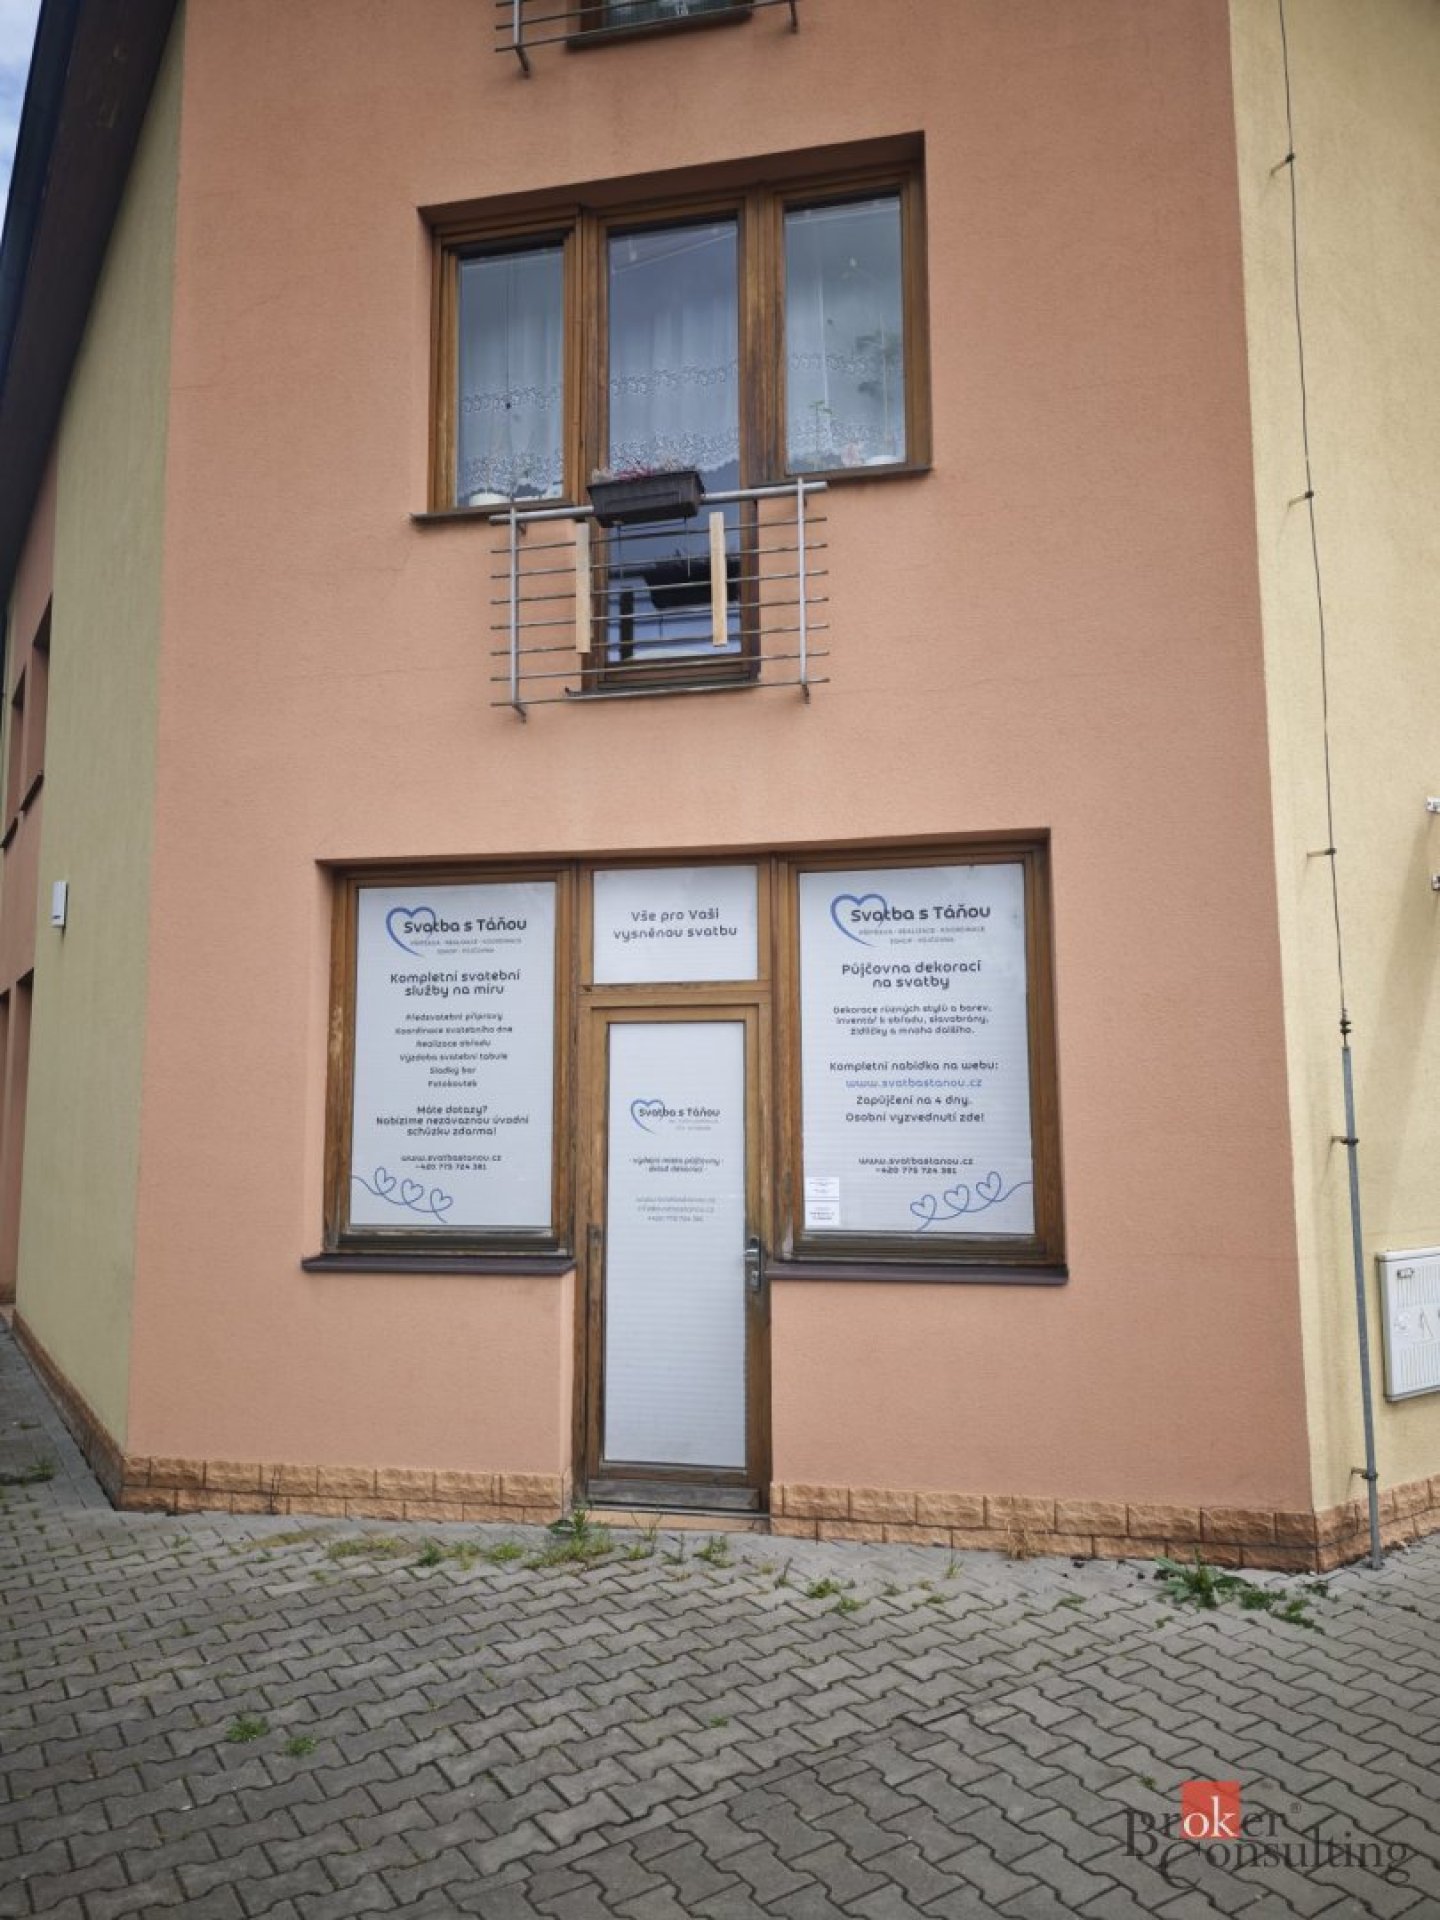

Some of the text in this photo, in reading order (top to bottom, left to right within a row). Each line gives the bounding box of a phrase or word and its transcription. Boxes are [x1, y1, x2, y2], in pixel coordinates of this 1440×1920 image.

[631, 908, 719, 923] Vše pro Vaši
[851, 903, 991, 923] Svatba s Táňou
[403, 916, 527, 934] Svatba s Táňou
[613, 925, 737, 943] vysněnou svatbu
[842, 960, 981, 978] Půjčovna dekorací
[390, 969, 521, 986] Kompletní svatební
[872, 976, 950, 990] na svatby
[404, 983, 504, 998] služby na míru
[829, 1061, 998, 1071] Kompletní nabídka na webu:
[857, 1095, 913, 1107] Zapůjčení
[917, 1096, 931, 1105] na
[936, 1096, 942, 1104] 4
[846, 1111, 985, 1124] Osobní vyzvednutí zde!
